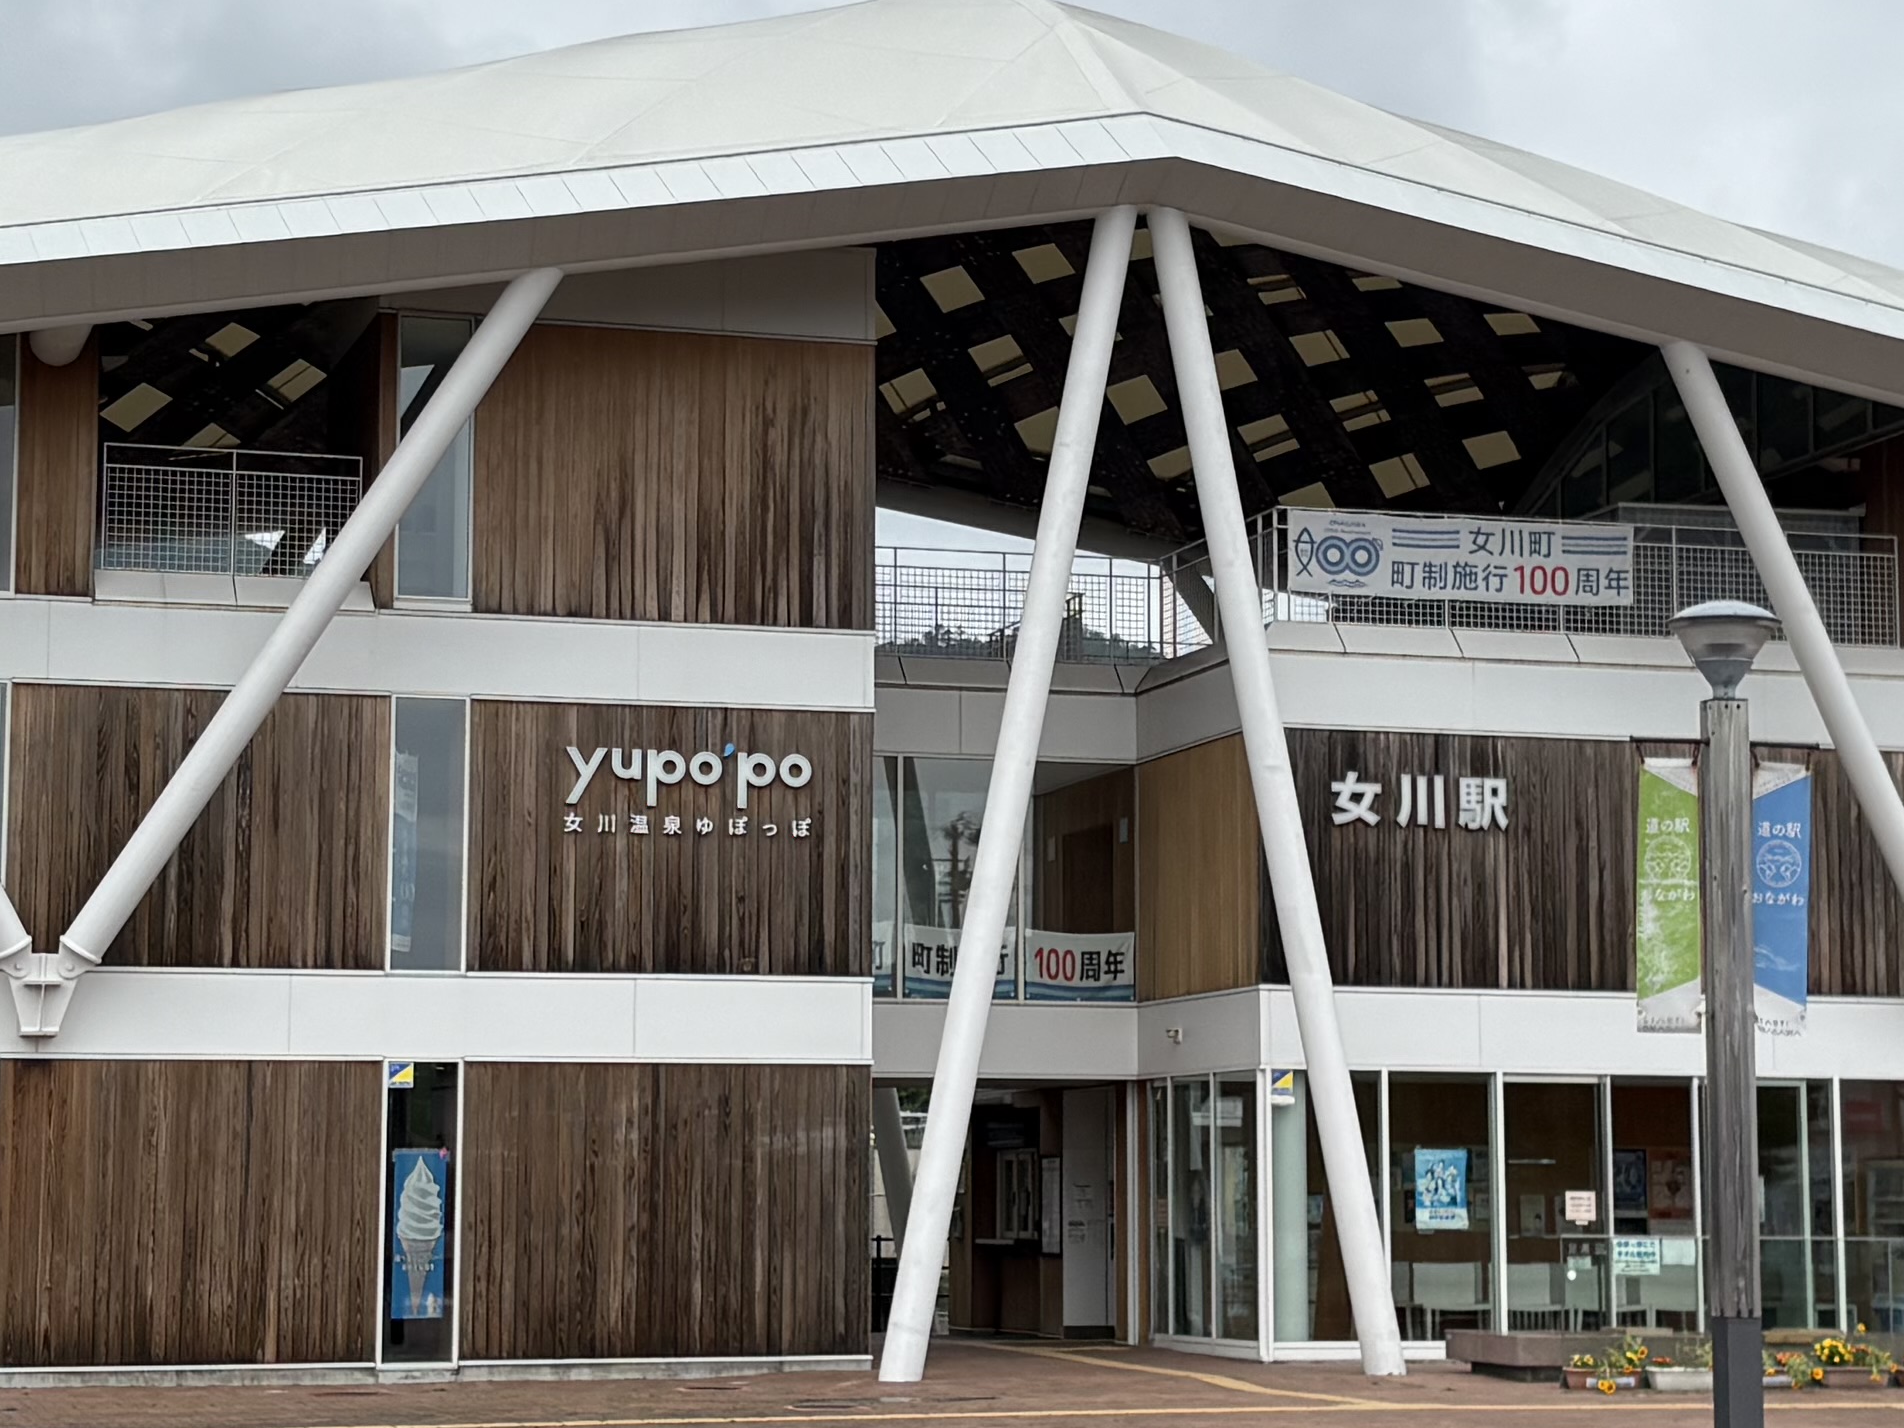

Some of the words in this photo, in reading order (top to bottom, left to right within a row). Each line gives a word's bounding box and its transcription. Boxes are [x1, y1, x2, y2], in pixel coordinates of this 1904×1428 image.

[1468, 527, 1556, 559] 女川町
[1391, 559, 1630, 598] 町制施行100周年
[1330, 771, 1509, 832] 女川駅
[563, 812, 812, 838] 女川温泉ゆぽっぽ
[1645, 817, 1691, 834] 道の駅
[1758, 821, 1801, 839] 道の駅
[1752, 891, 1805, 906] おながわ
[1034, 946, 1125, 982] 100周年
